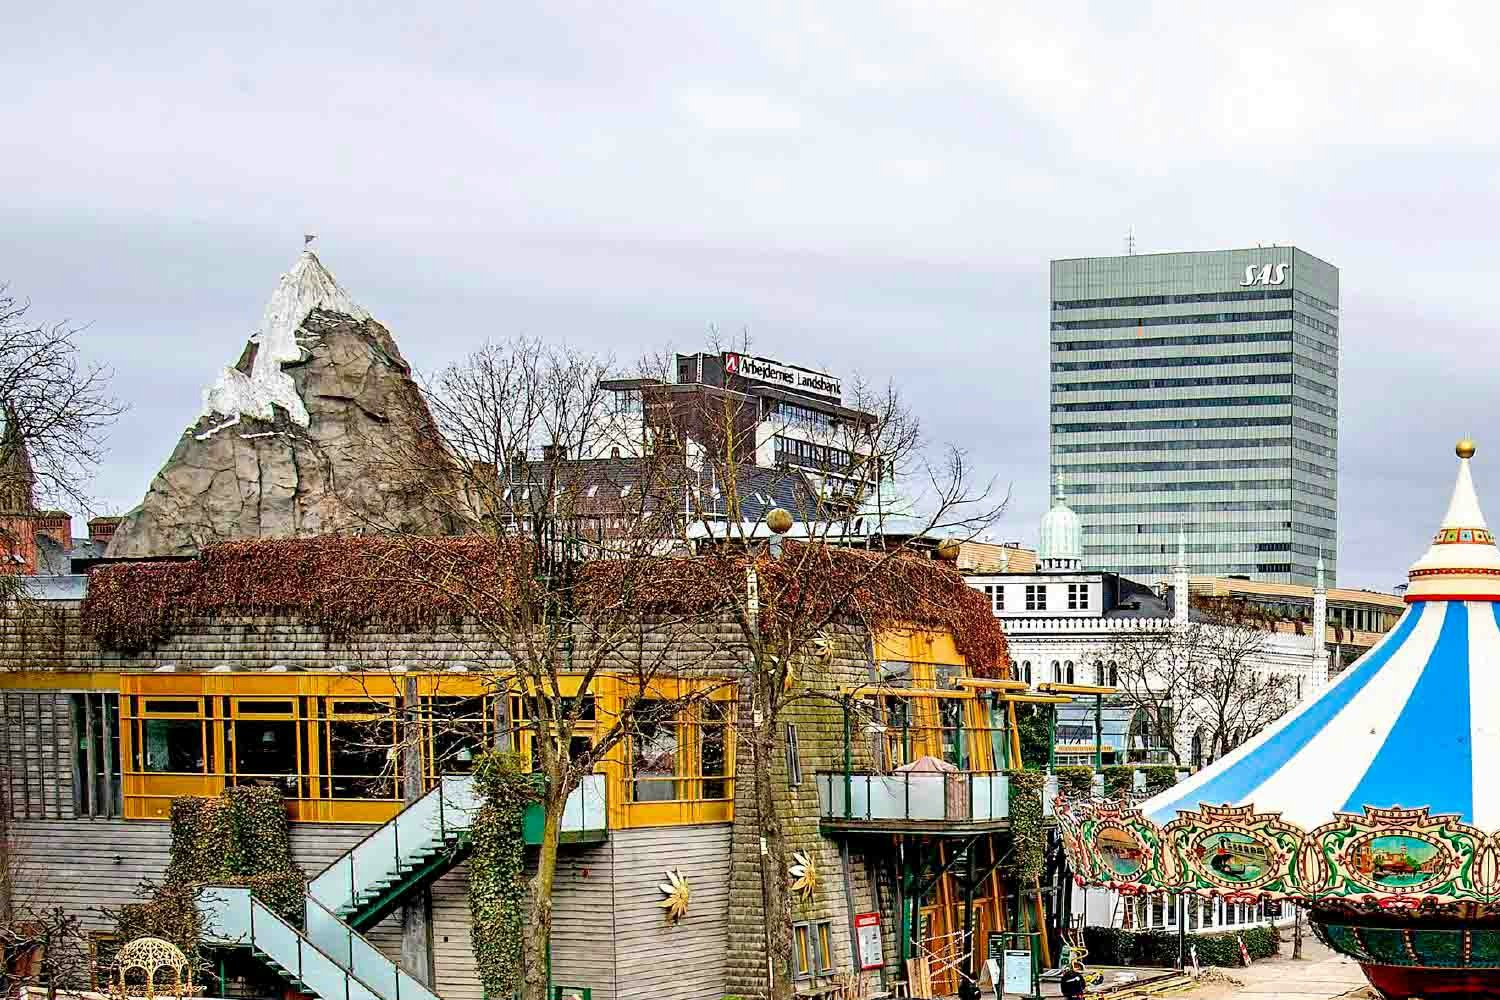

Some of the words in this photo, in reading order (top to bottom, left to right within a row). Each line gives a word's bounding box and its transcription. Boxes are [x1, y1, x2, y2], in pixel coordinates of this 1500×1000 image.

[1240, 264, 1289, 286] SAS
[741, 360, 794, 384] Arbejdernes
[797, 372, 842, 395] Landsbank
